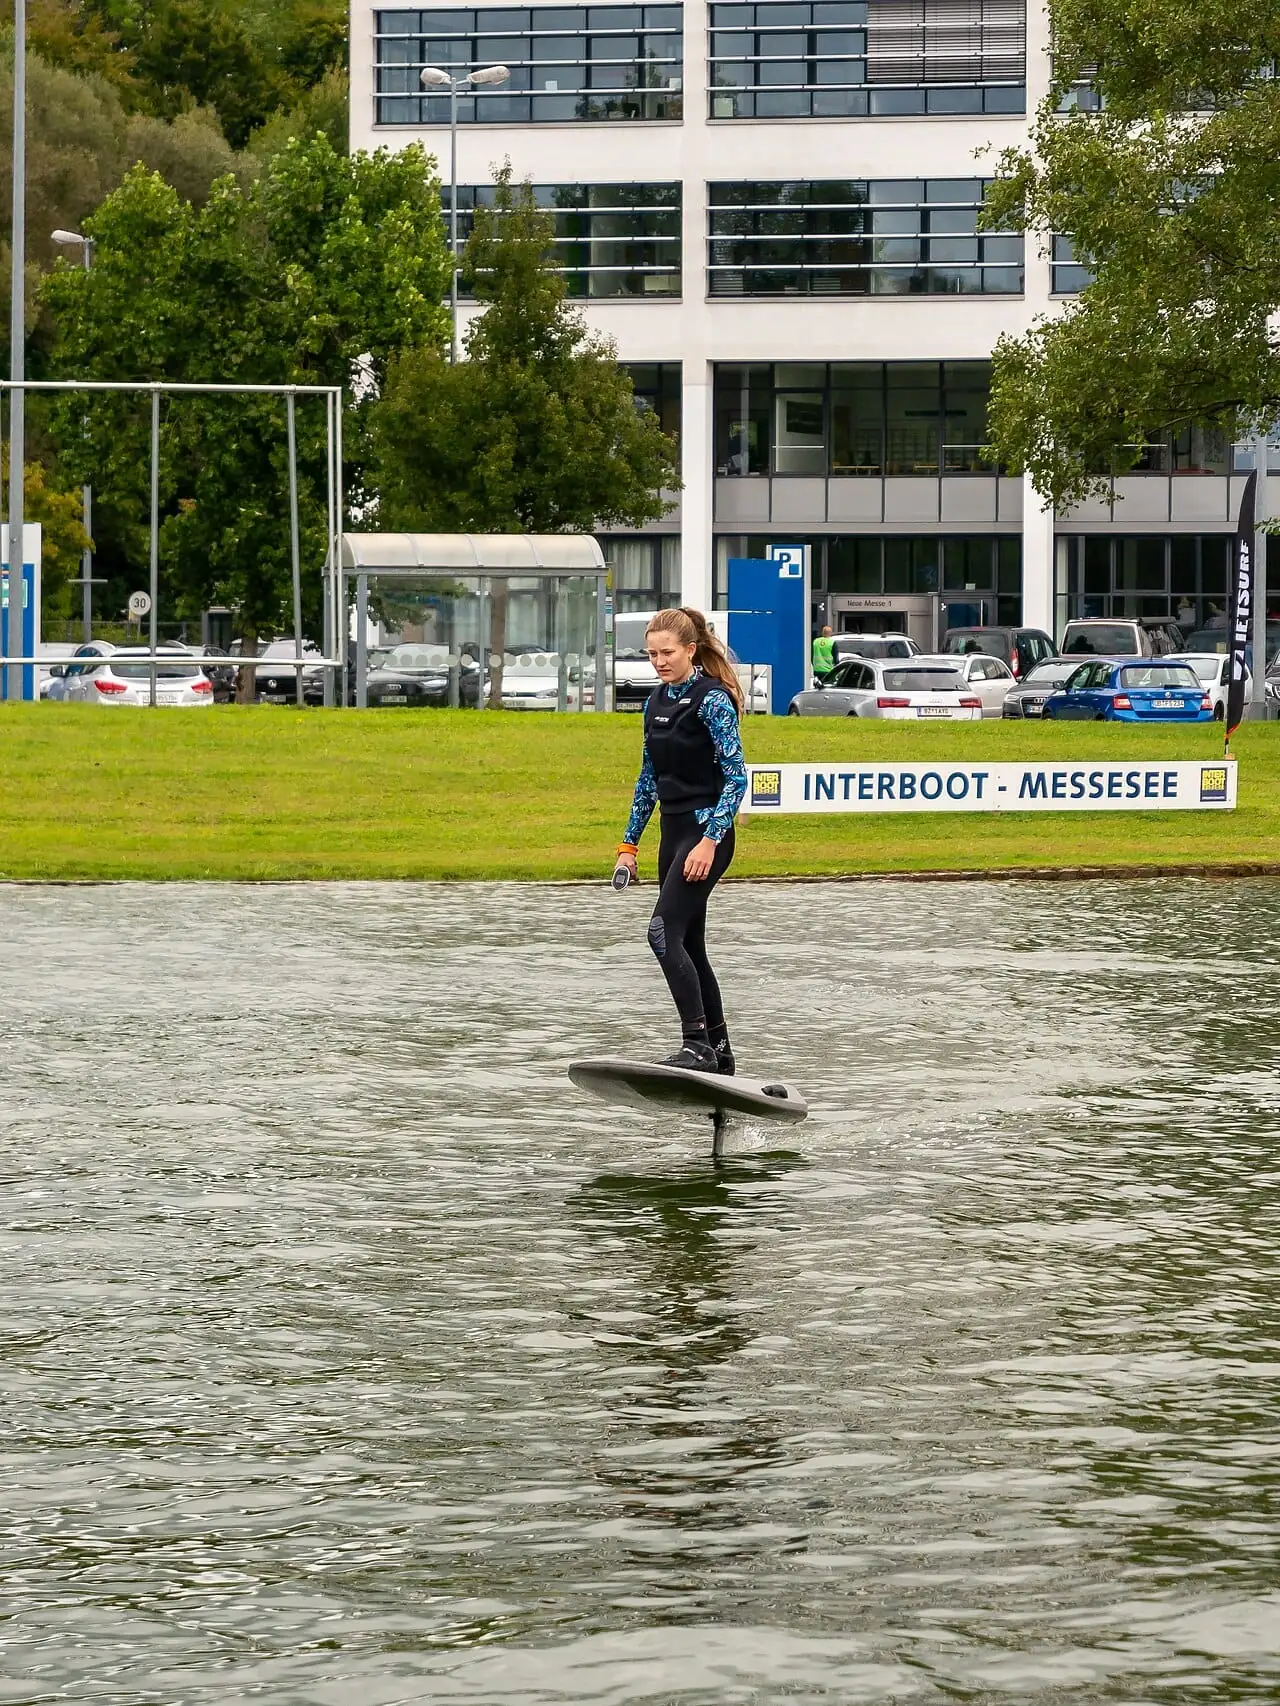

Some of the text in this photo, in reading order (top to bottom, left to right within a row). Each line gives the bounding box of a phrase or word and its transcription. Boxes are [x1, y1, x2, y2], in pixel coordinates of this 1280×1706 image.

[134, 597, 146, 608] 30
[753, 772, 779, 781] INTER
[753, 781, 779, 791] BOOT
[803, 771, 989, 800] INTERBOOT
[1018, 771, 1178, 799] MESSESEE
[1202, 778, 1225, 788] BOOT
